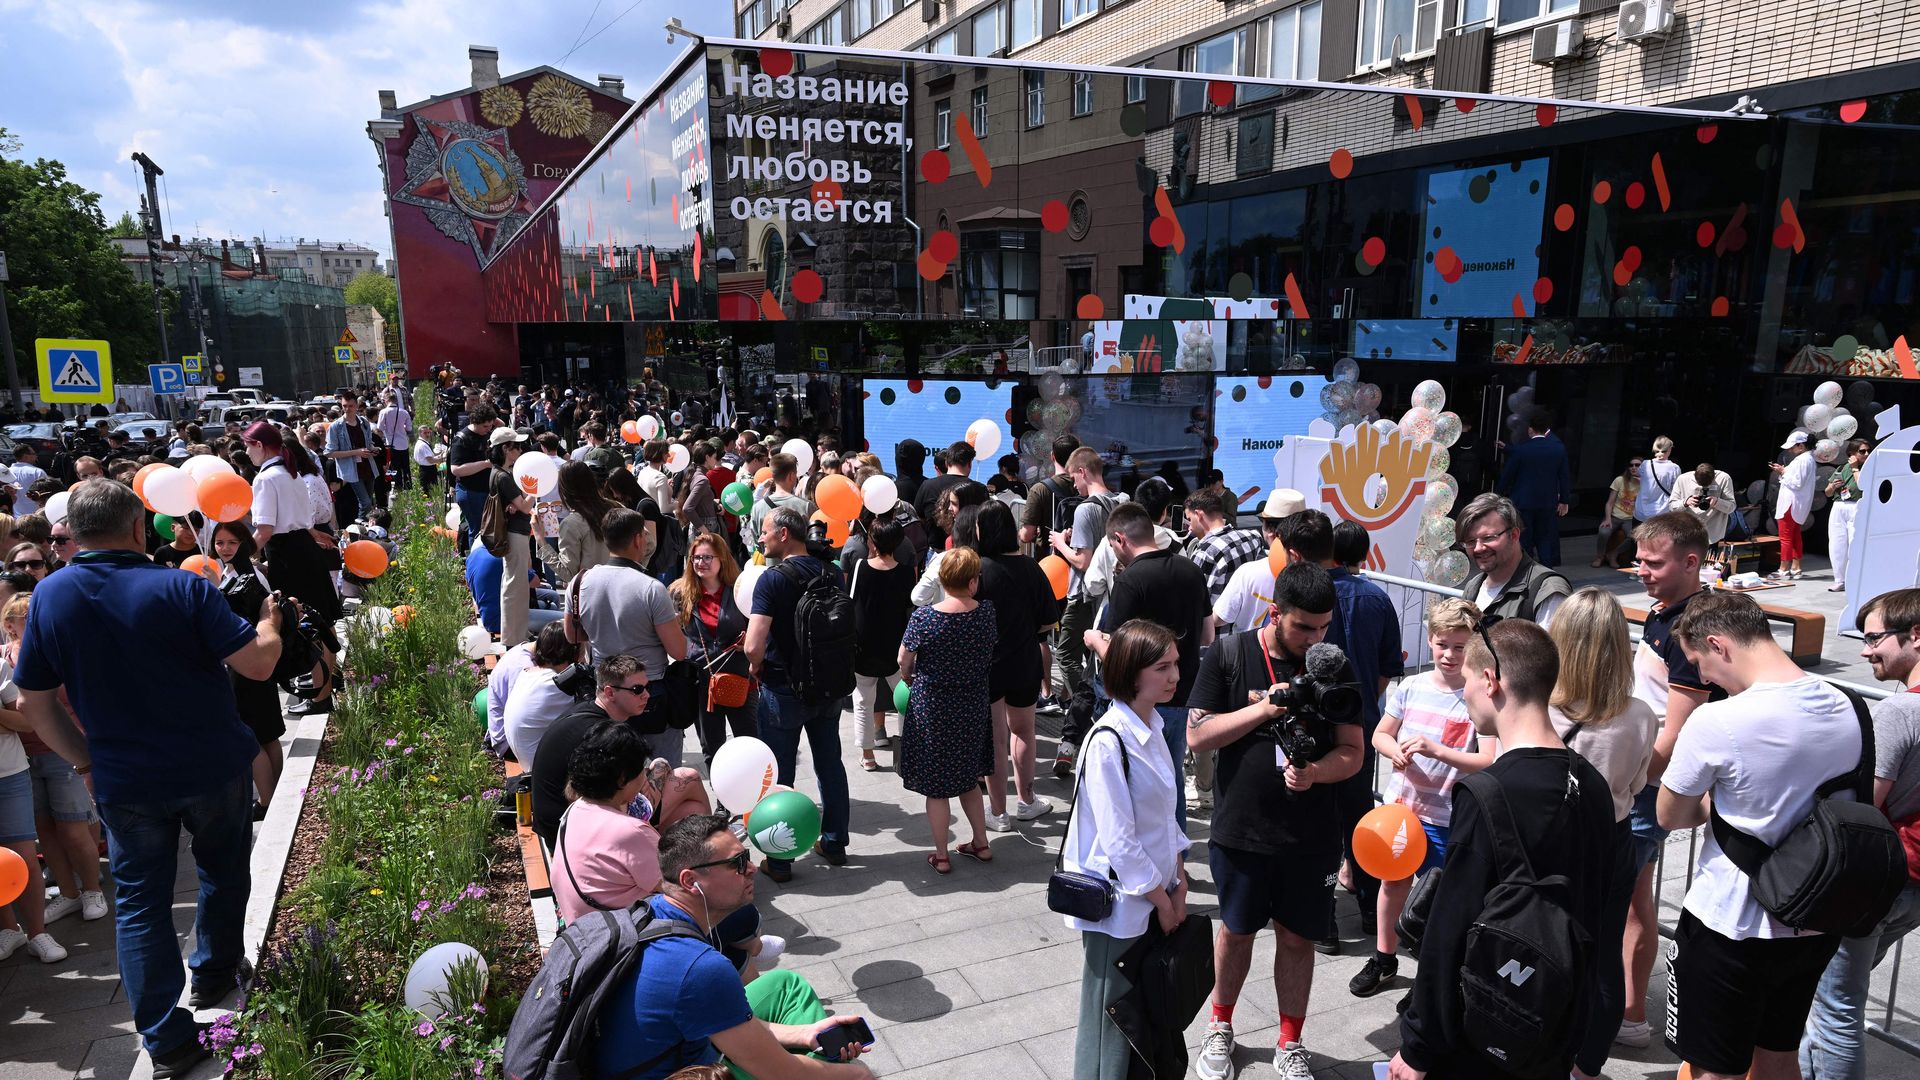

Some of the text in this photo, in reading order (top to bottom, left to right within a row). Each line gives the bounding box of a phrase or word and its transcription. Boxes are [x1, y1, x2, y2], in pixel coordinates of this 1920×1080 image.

[670, 74, 705, 124] Название
[724, 63, 909, 106] Название
[672, 116, 707, 161] меняется,
[726, 113, 914, 152] меняется,
[681, 158, 709, 194] любовь
[729, 151, 872, 184] любовь
[680, 195, 711, 231] остаётся
[730, 191, 892, 224] остаётся
[1496, 958, 1536, 987] N
